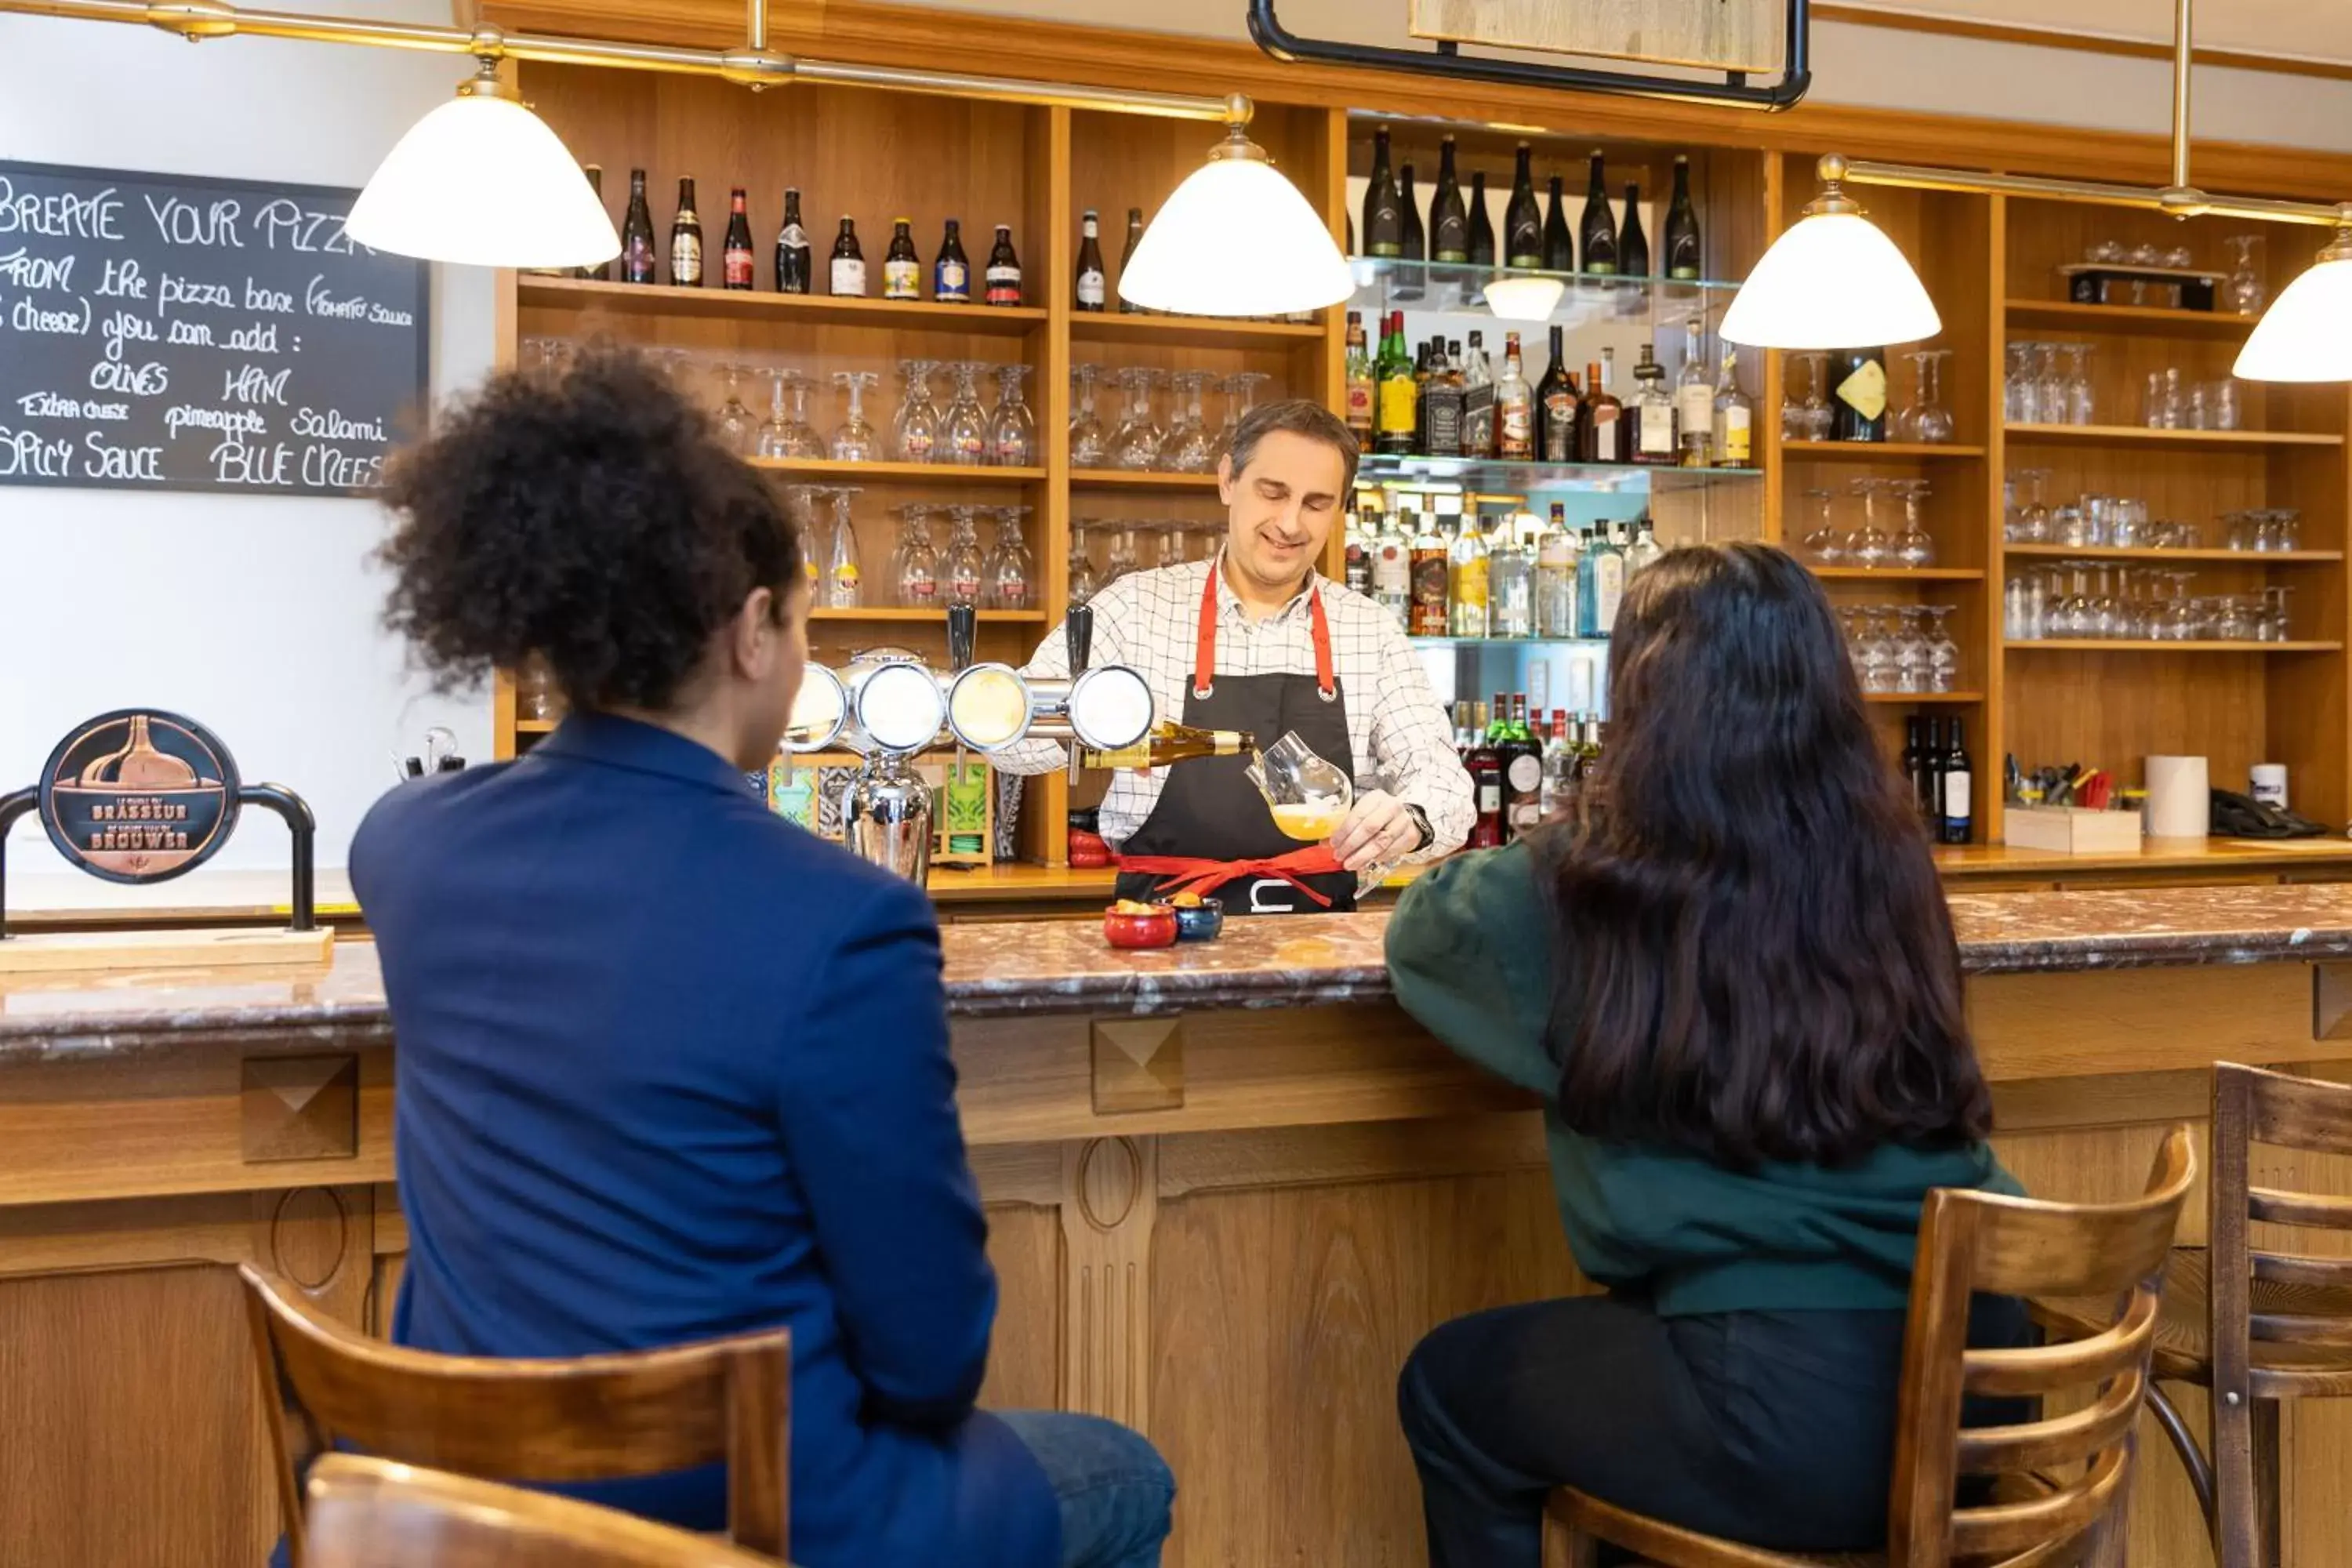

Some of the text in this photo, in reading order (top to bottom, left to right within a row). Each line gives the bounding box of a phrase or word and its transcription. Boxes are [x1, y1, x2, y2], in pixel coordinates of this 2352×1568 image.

[144, 194, 244, 246] YOUR
[94, 259, 148, 299] the
[158, 273, 236, 318] pizza
[245, 276, 295, 314] base
[102, 310, 158, 361] you
[219, 321, 279, 353] add
[221, 364, 292, 405] HAM
[165, 404, 267, 442] pineapple
[290, 407, 387, 441] Salami
[209, 441, 296, 485] BLUE
[92, 804, 187, 820] BRASSEUR
[91, 833, 187, 850] BROUWER
